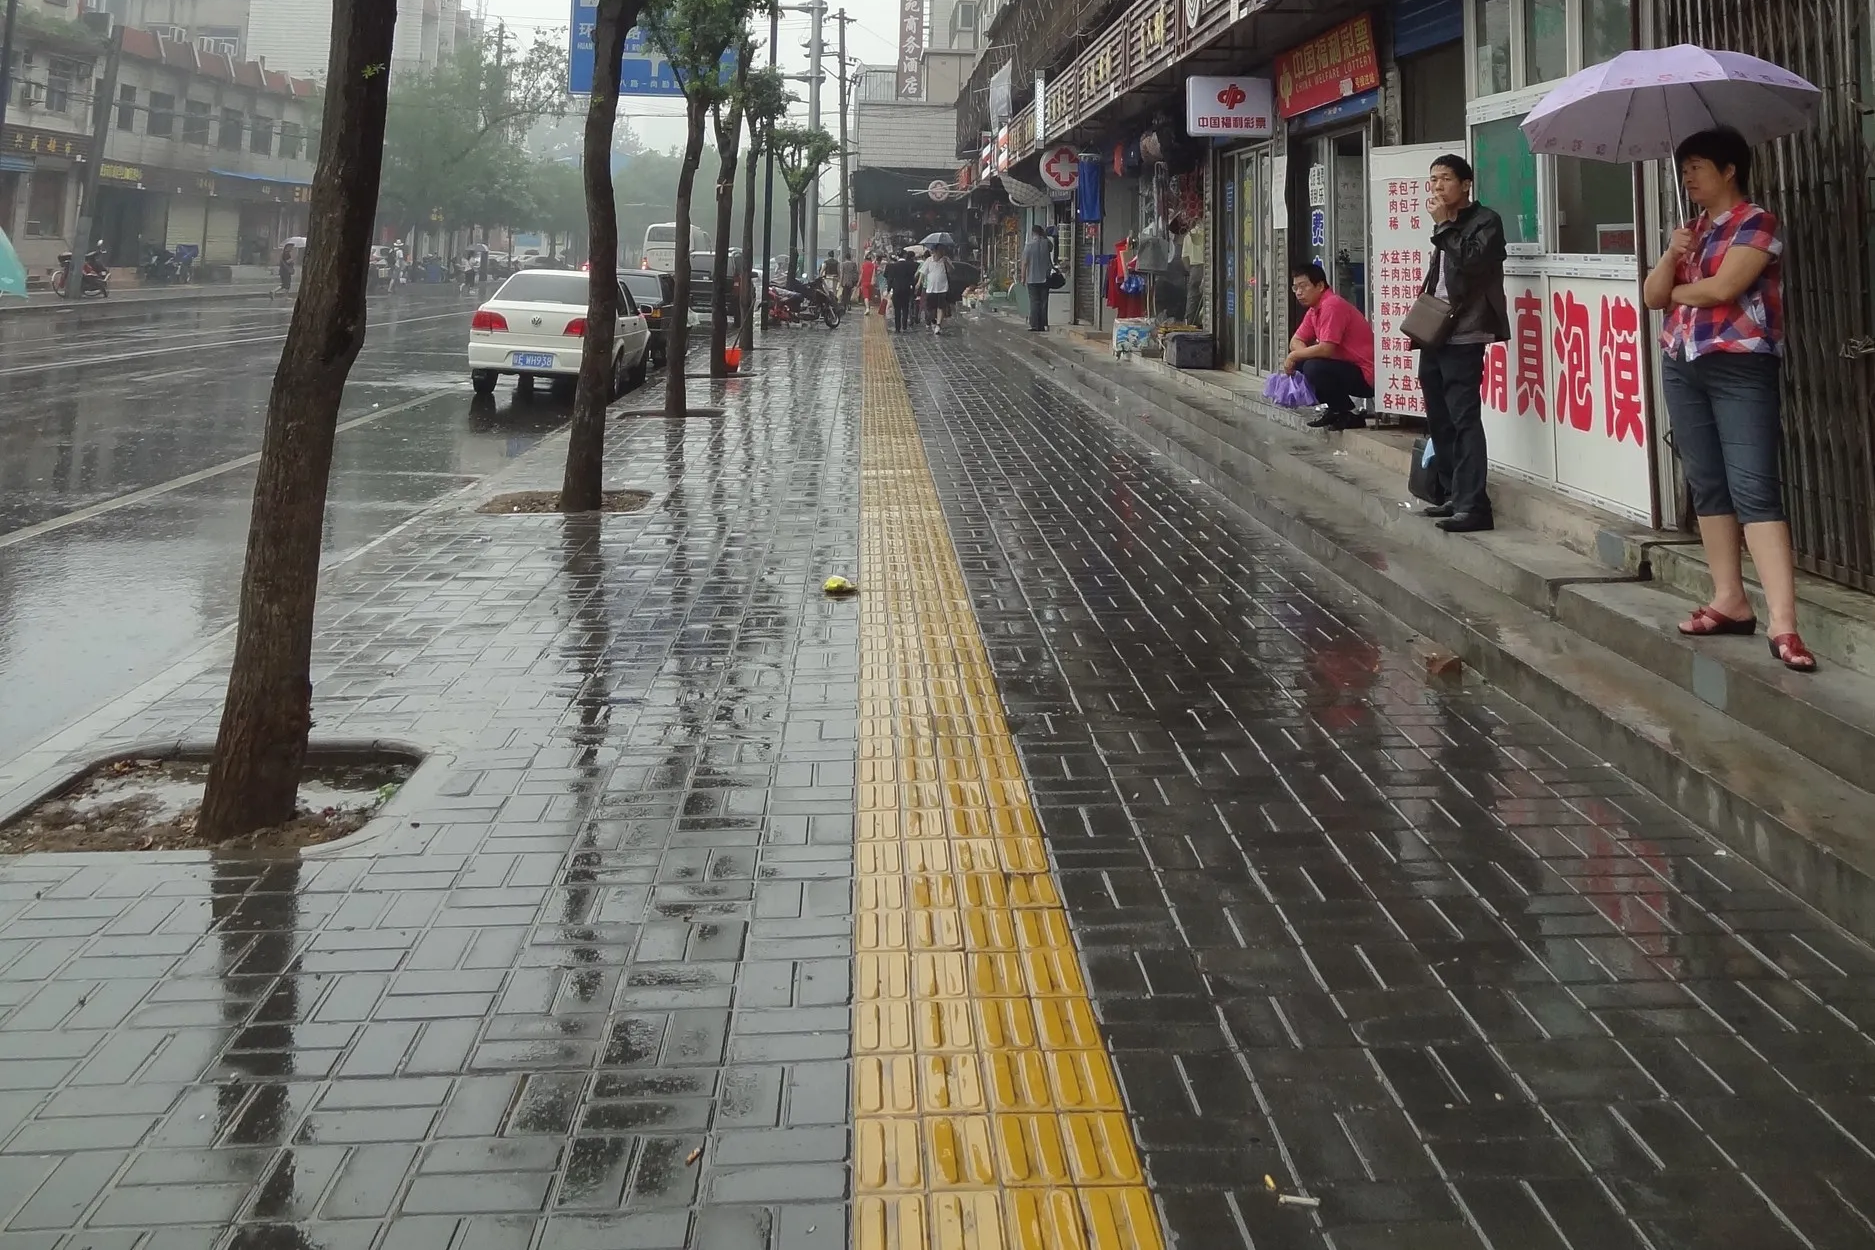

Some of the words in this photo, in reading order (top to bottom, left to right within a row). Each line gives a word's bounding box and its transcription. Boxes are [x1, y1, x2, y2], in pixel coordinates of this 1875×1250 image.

[1292, 18, 1370, 79] 中国福利彩票
[1295, 79, 1312, 93] CHINA
[1314, 68, 1340, 86] WELFARE
[1344, 54, 1372, 74] LOTTERY
[1198, 117, 1266, 129] 中国福利彩票
[1388, 181, 1419, 196] 菜包子
[1389, 198, 1420, 213] 肉包子
[1381, 250, 1422, 264] 水盆羊肉
[1381, 268, 1422, 282] 牛肉泡馍
[1382, 355, 1413, 370] 牛肉面
